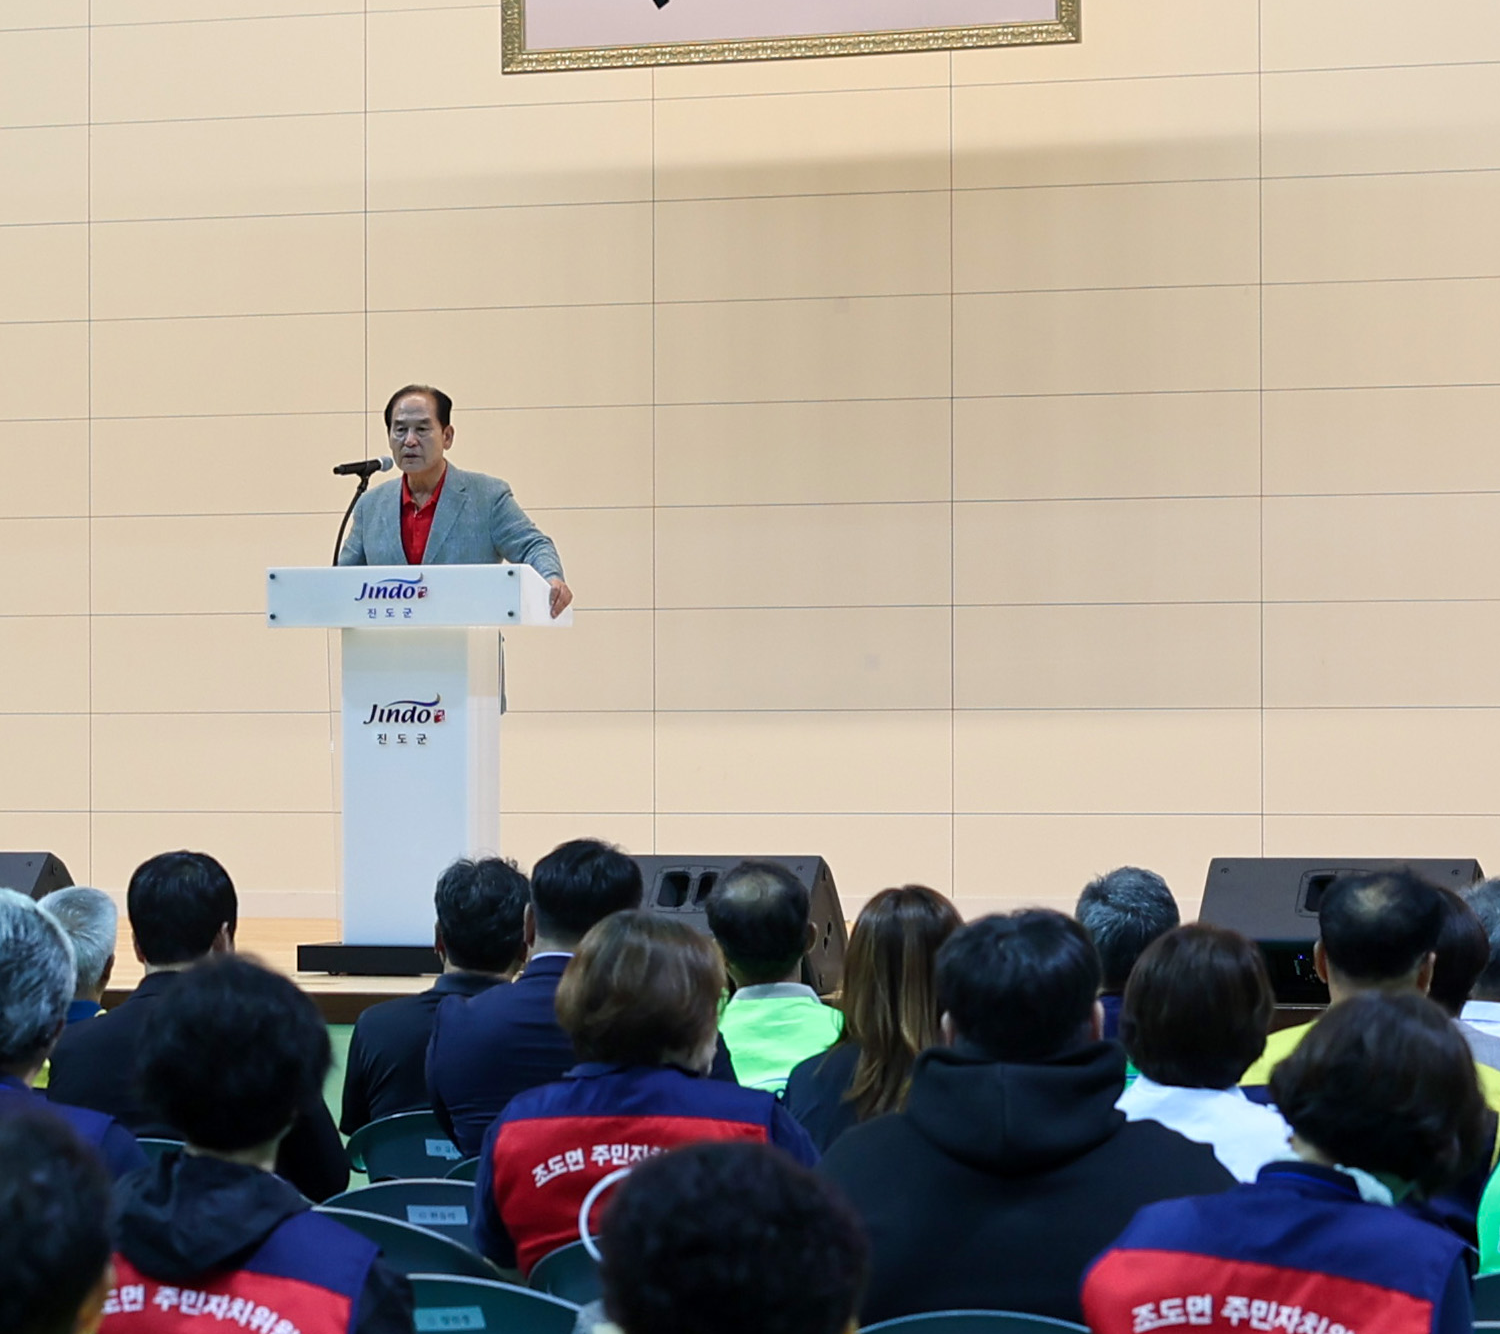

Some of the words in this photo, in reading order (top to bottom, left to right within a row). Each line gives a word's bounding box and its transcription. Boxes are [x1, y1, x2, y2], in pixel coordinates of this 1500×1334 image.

[354, 582, 416, 601] Jindo
[363, 703, 431, 725] Jindo
[531, 1146, 586, 1188] 조도면
[1130, 1292, 1214, 1334] 조도면
